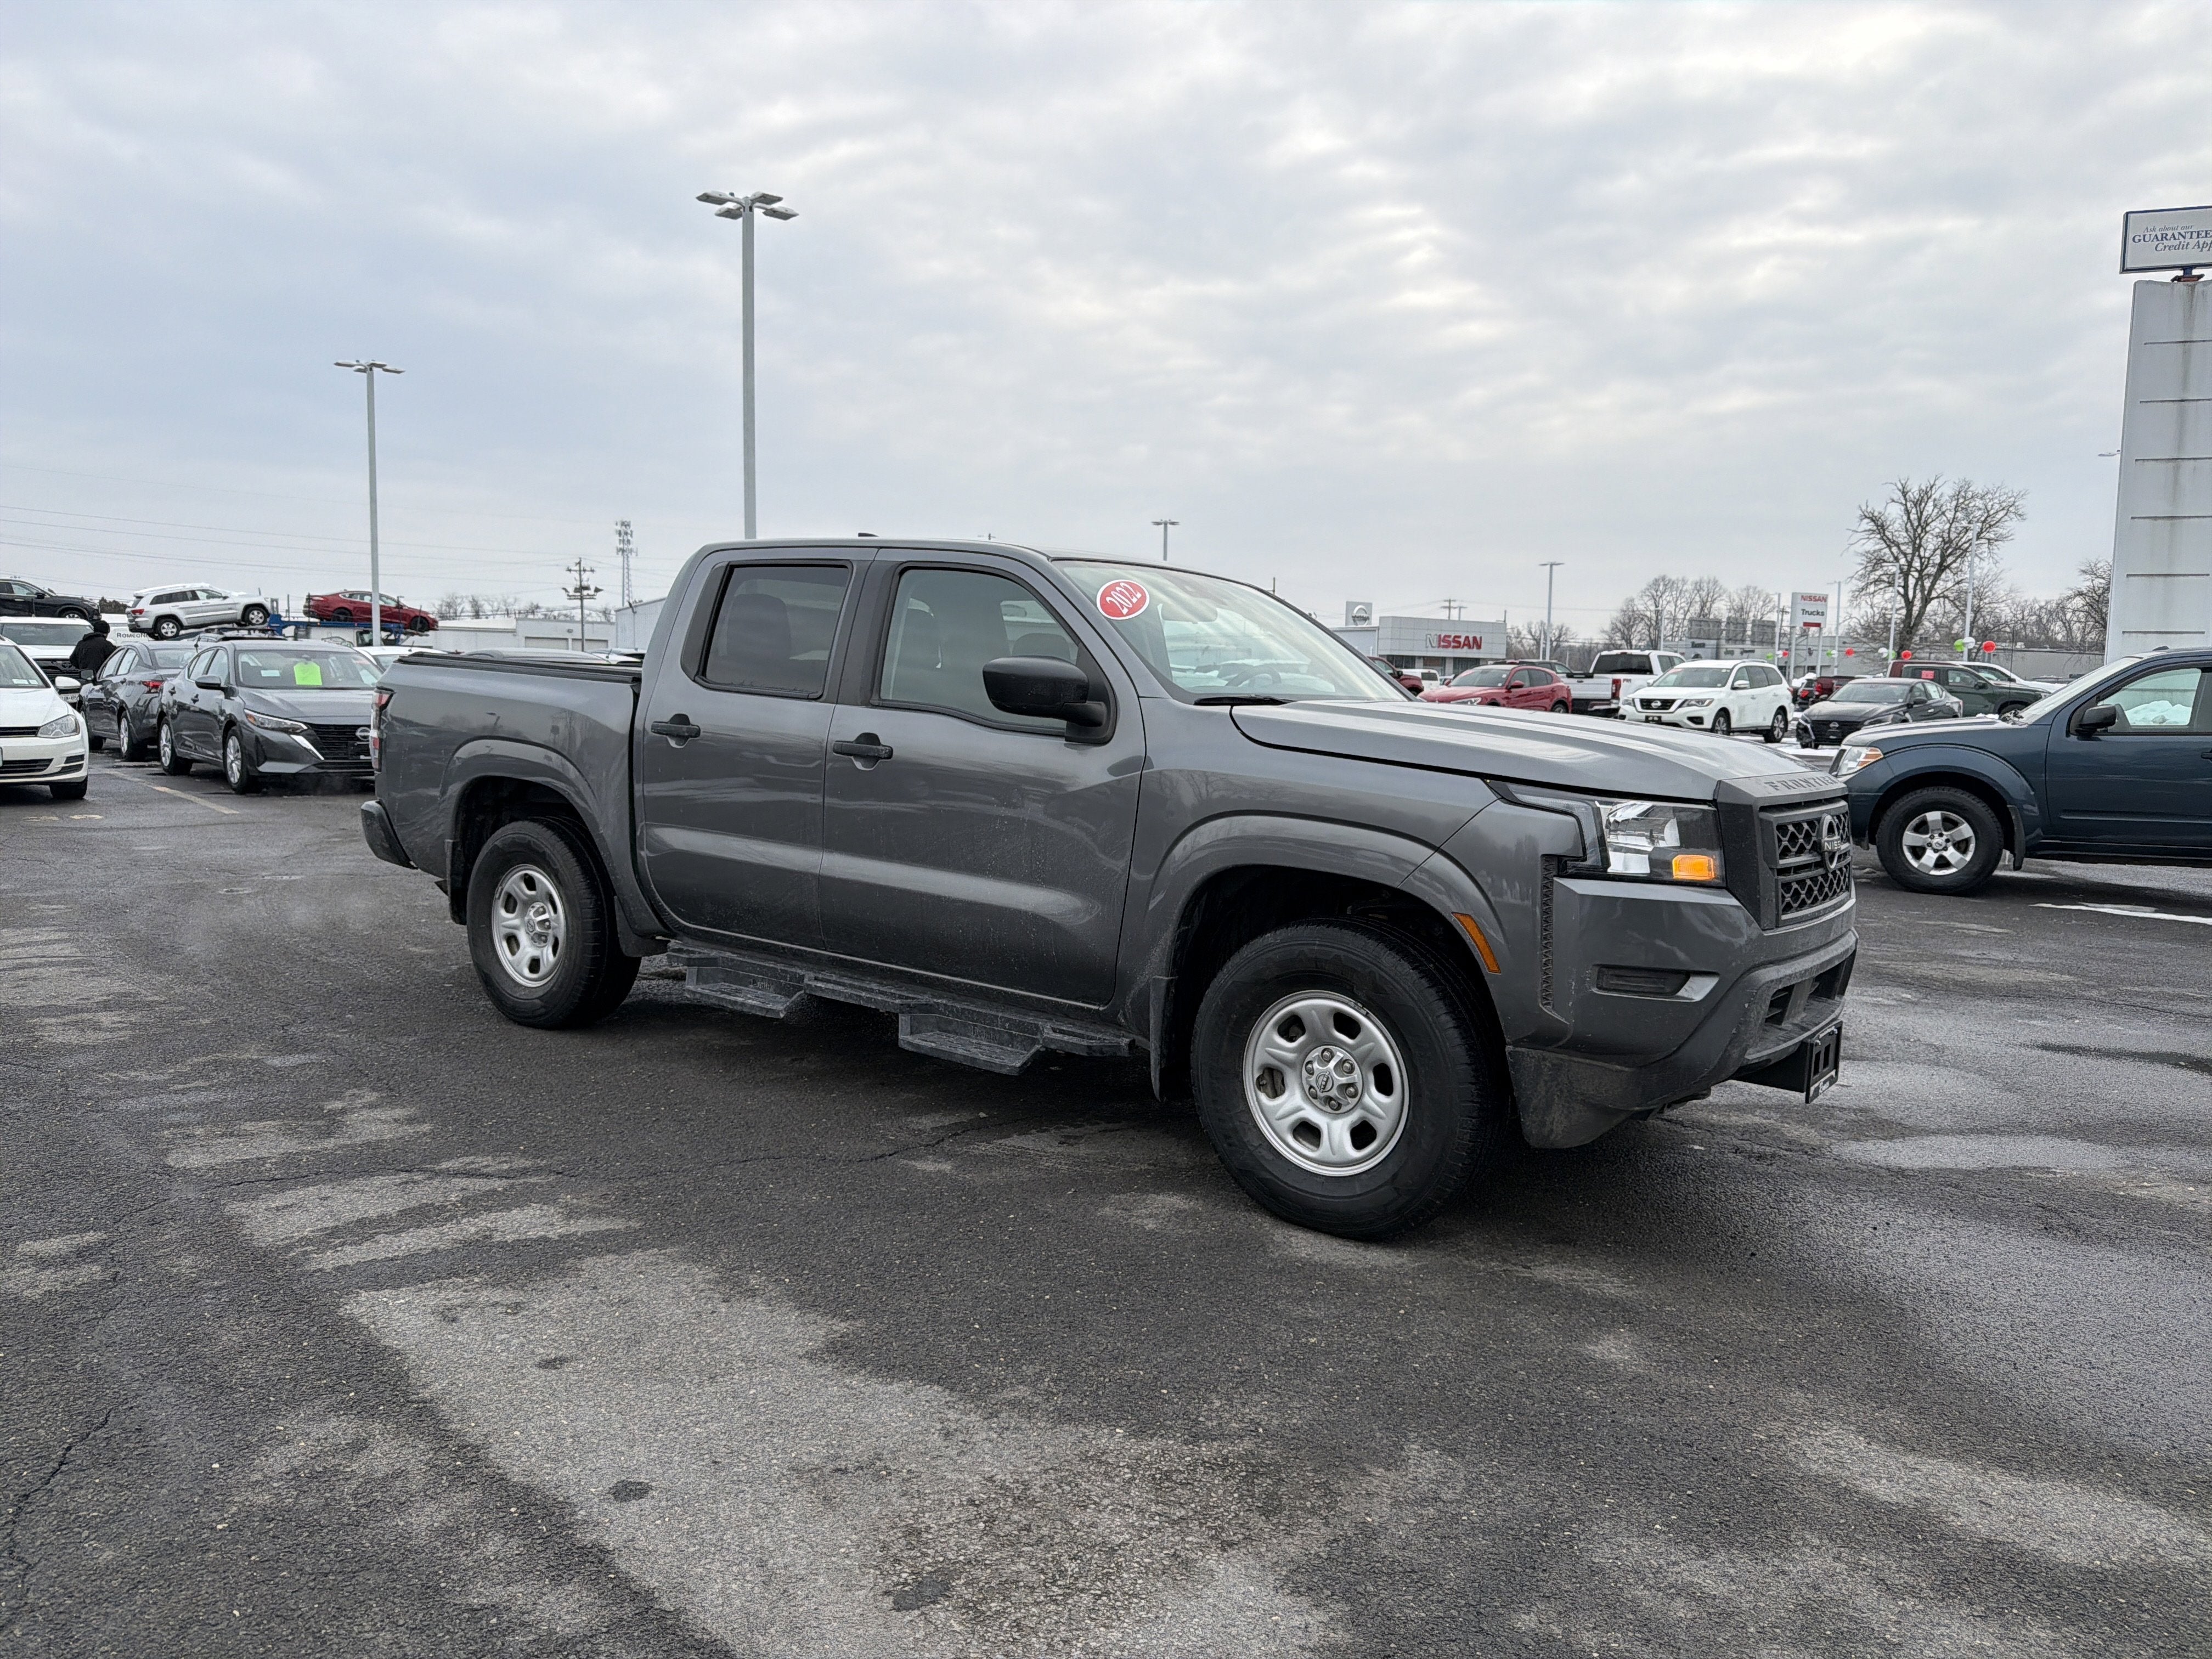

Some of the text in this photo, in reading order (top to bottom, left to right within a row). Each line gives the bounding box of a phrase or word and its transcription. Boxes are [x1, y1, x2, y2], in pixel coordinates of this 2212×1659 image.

[2154, 240, 2190, 252] Credit
[1105, 582, 1142, 615] 2022
[1801, 608, 1825, 617] Trucks
[1426, 633, 1482, 650] NISSAN
[1824, 840, 1841, 850] NISS
